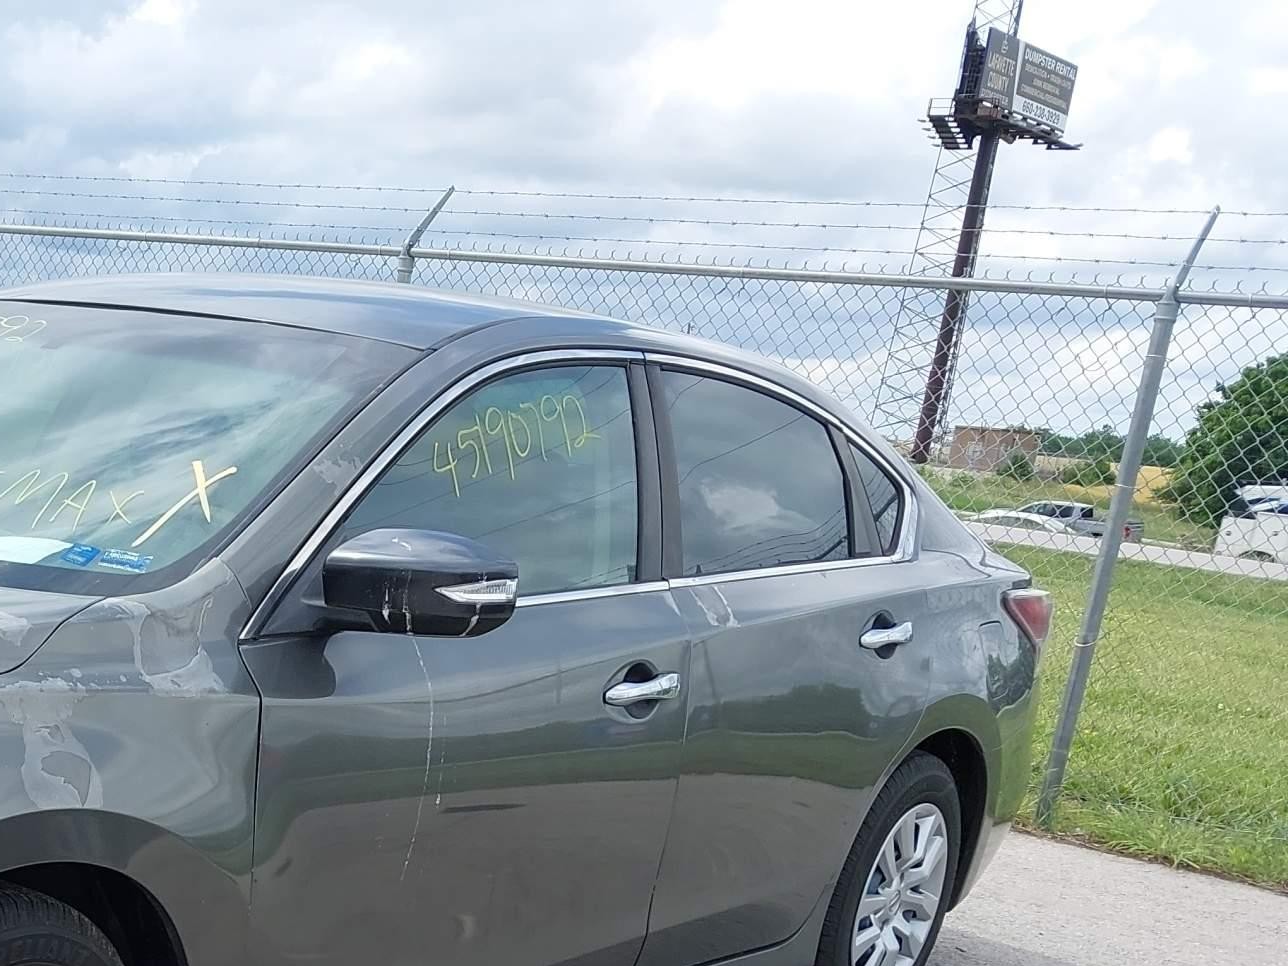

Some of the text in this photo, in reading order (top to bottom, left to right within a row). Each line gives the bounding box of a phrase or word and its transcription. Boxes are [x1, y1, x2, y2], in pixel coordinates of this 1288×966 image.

[1024, 47, 1076, 80] DUMPSTER RENTAL
[987, 71, 1010, 92] COUNTY
[433, 395, 601, 498] 45190792
